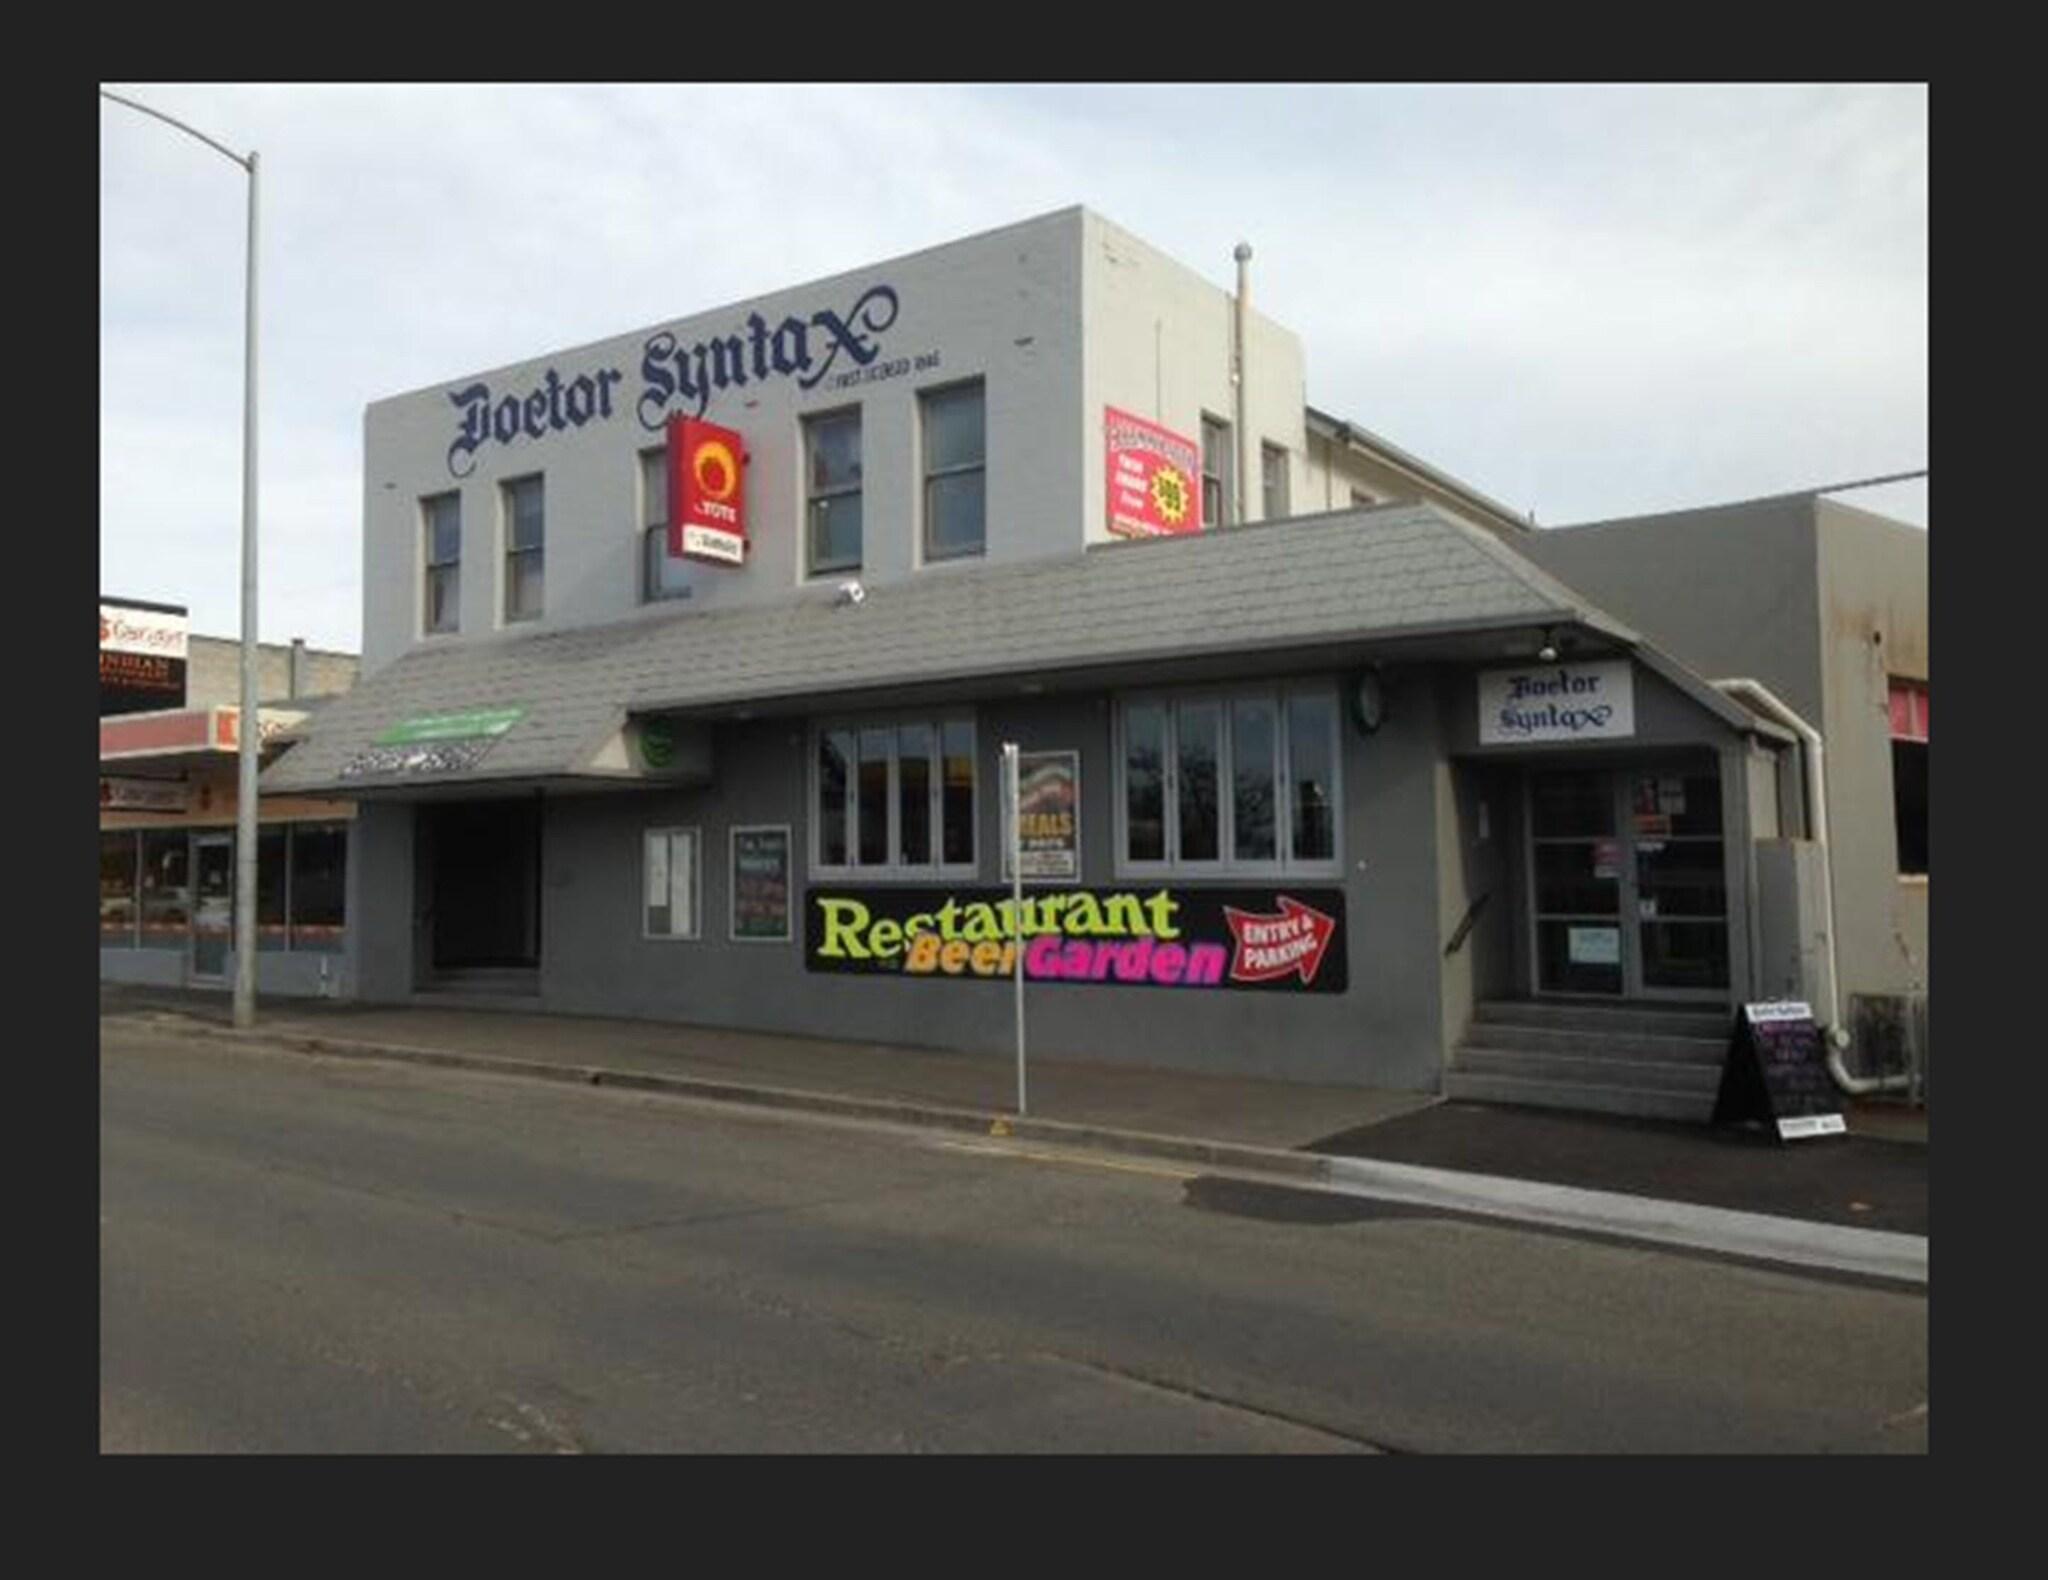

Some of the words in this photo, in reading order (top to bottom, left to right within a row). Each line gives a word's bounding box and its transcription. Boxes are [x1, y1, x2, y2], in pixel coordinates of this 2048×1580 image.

[448, 367, 621, 479] Doctor
[637, 285, 898, 431] Syntax
[1508, 669, 1600, 698] Doctor
[1499, 702, 1613, 735] Syntax
[817, 890, 1180, 958] Restaurant
[1243, 919, 1300, 946] ENTRY
[905, 931, 1019, 975] Beer
[1025, 933, 1229, 984] Garden
[1244, 934, 1318, 969] PARKING
